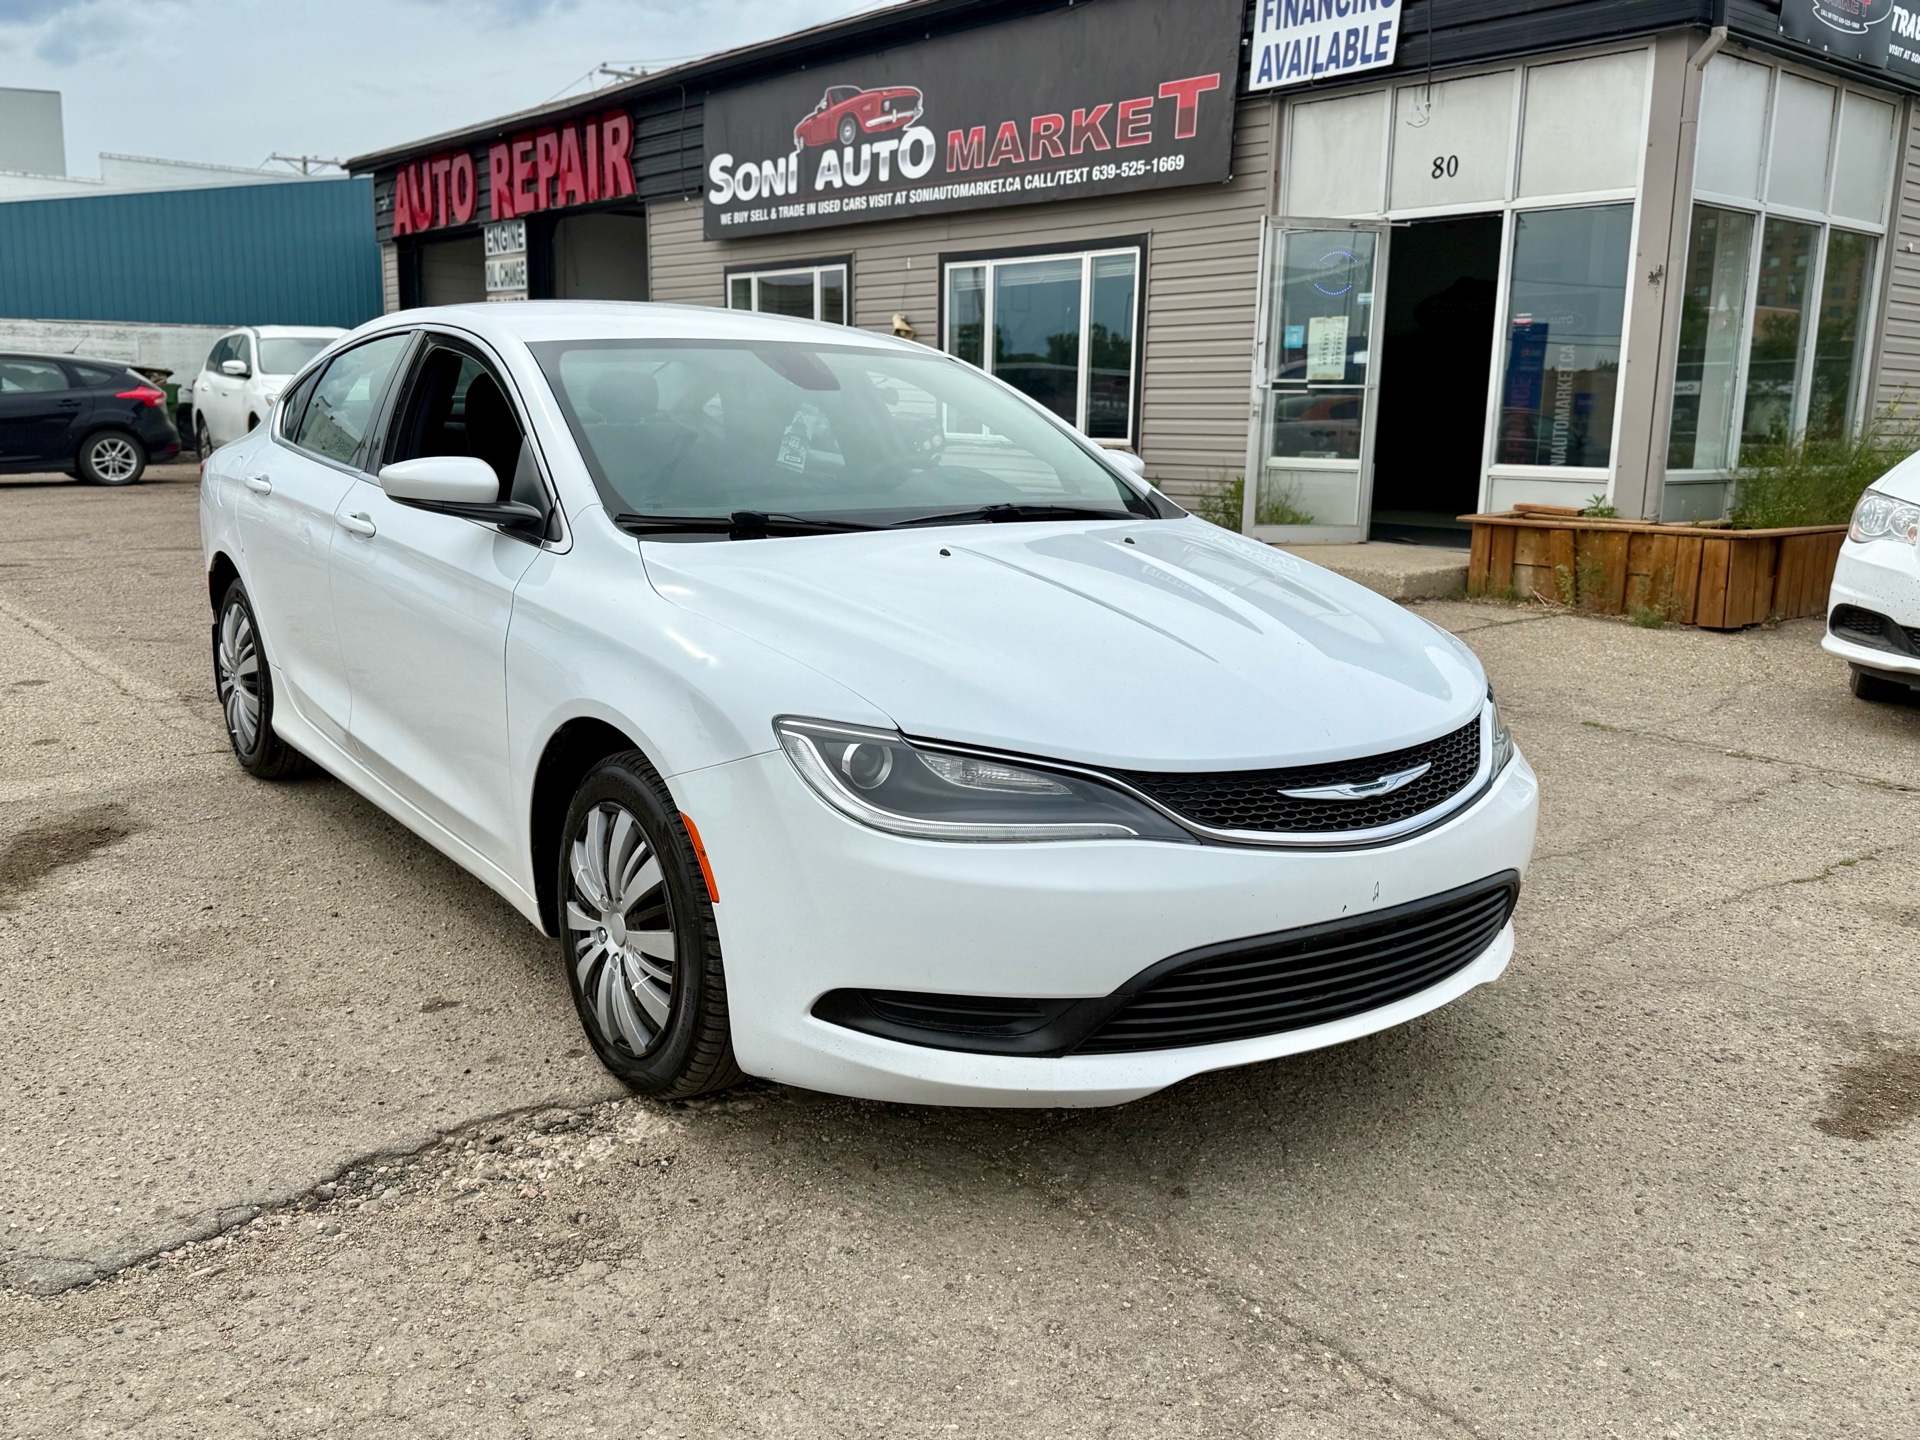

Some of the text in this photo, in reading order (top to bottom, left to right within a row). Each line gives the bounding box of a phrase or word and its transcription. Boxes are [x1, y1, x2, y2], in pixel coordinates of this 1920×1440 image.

[1256, 20, 1393, 84] AVAILABLE
[1889, 43, 1904, 57] VISIT
[1903, 50, 1911, 60] AT
[708, 73, 1220, 205] SONI AUTO MARKET
[1431, 155, 1459, 179] 80
[393, 109, 637, 236] AUTO REPAIR
[720, 154, 1185, 225] WE BUY SELL & TRADE IN USED CARS VISIT AT SONIAUTOMARKET.CA CALL/TEXT 639-525-1669
[487, 223, 523, 253] ENGINE
